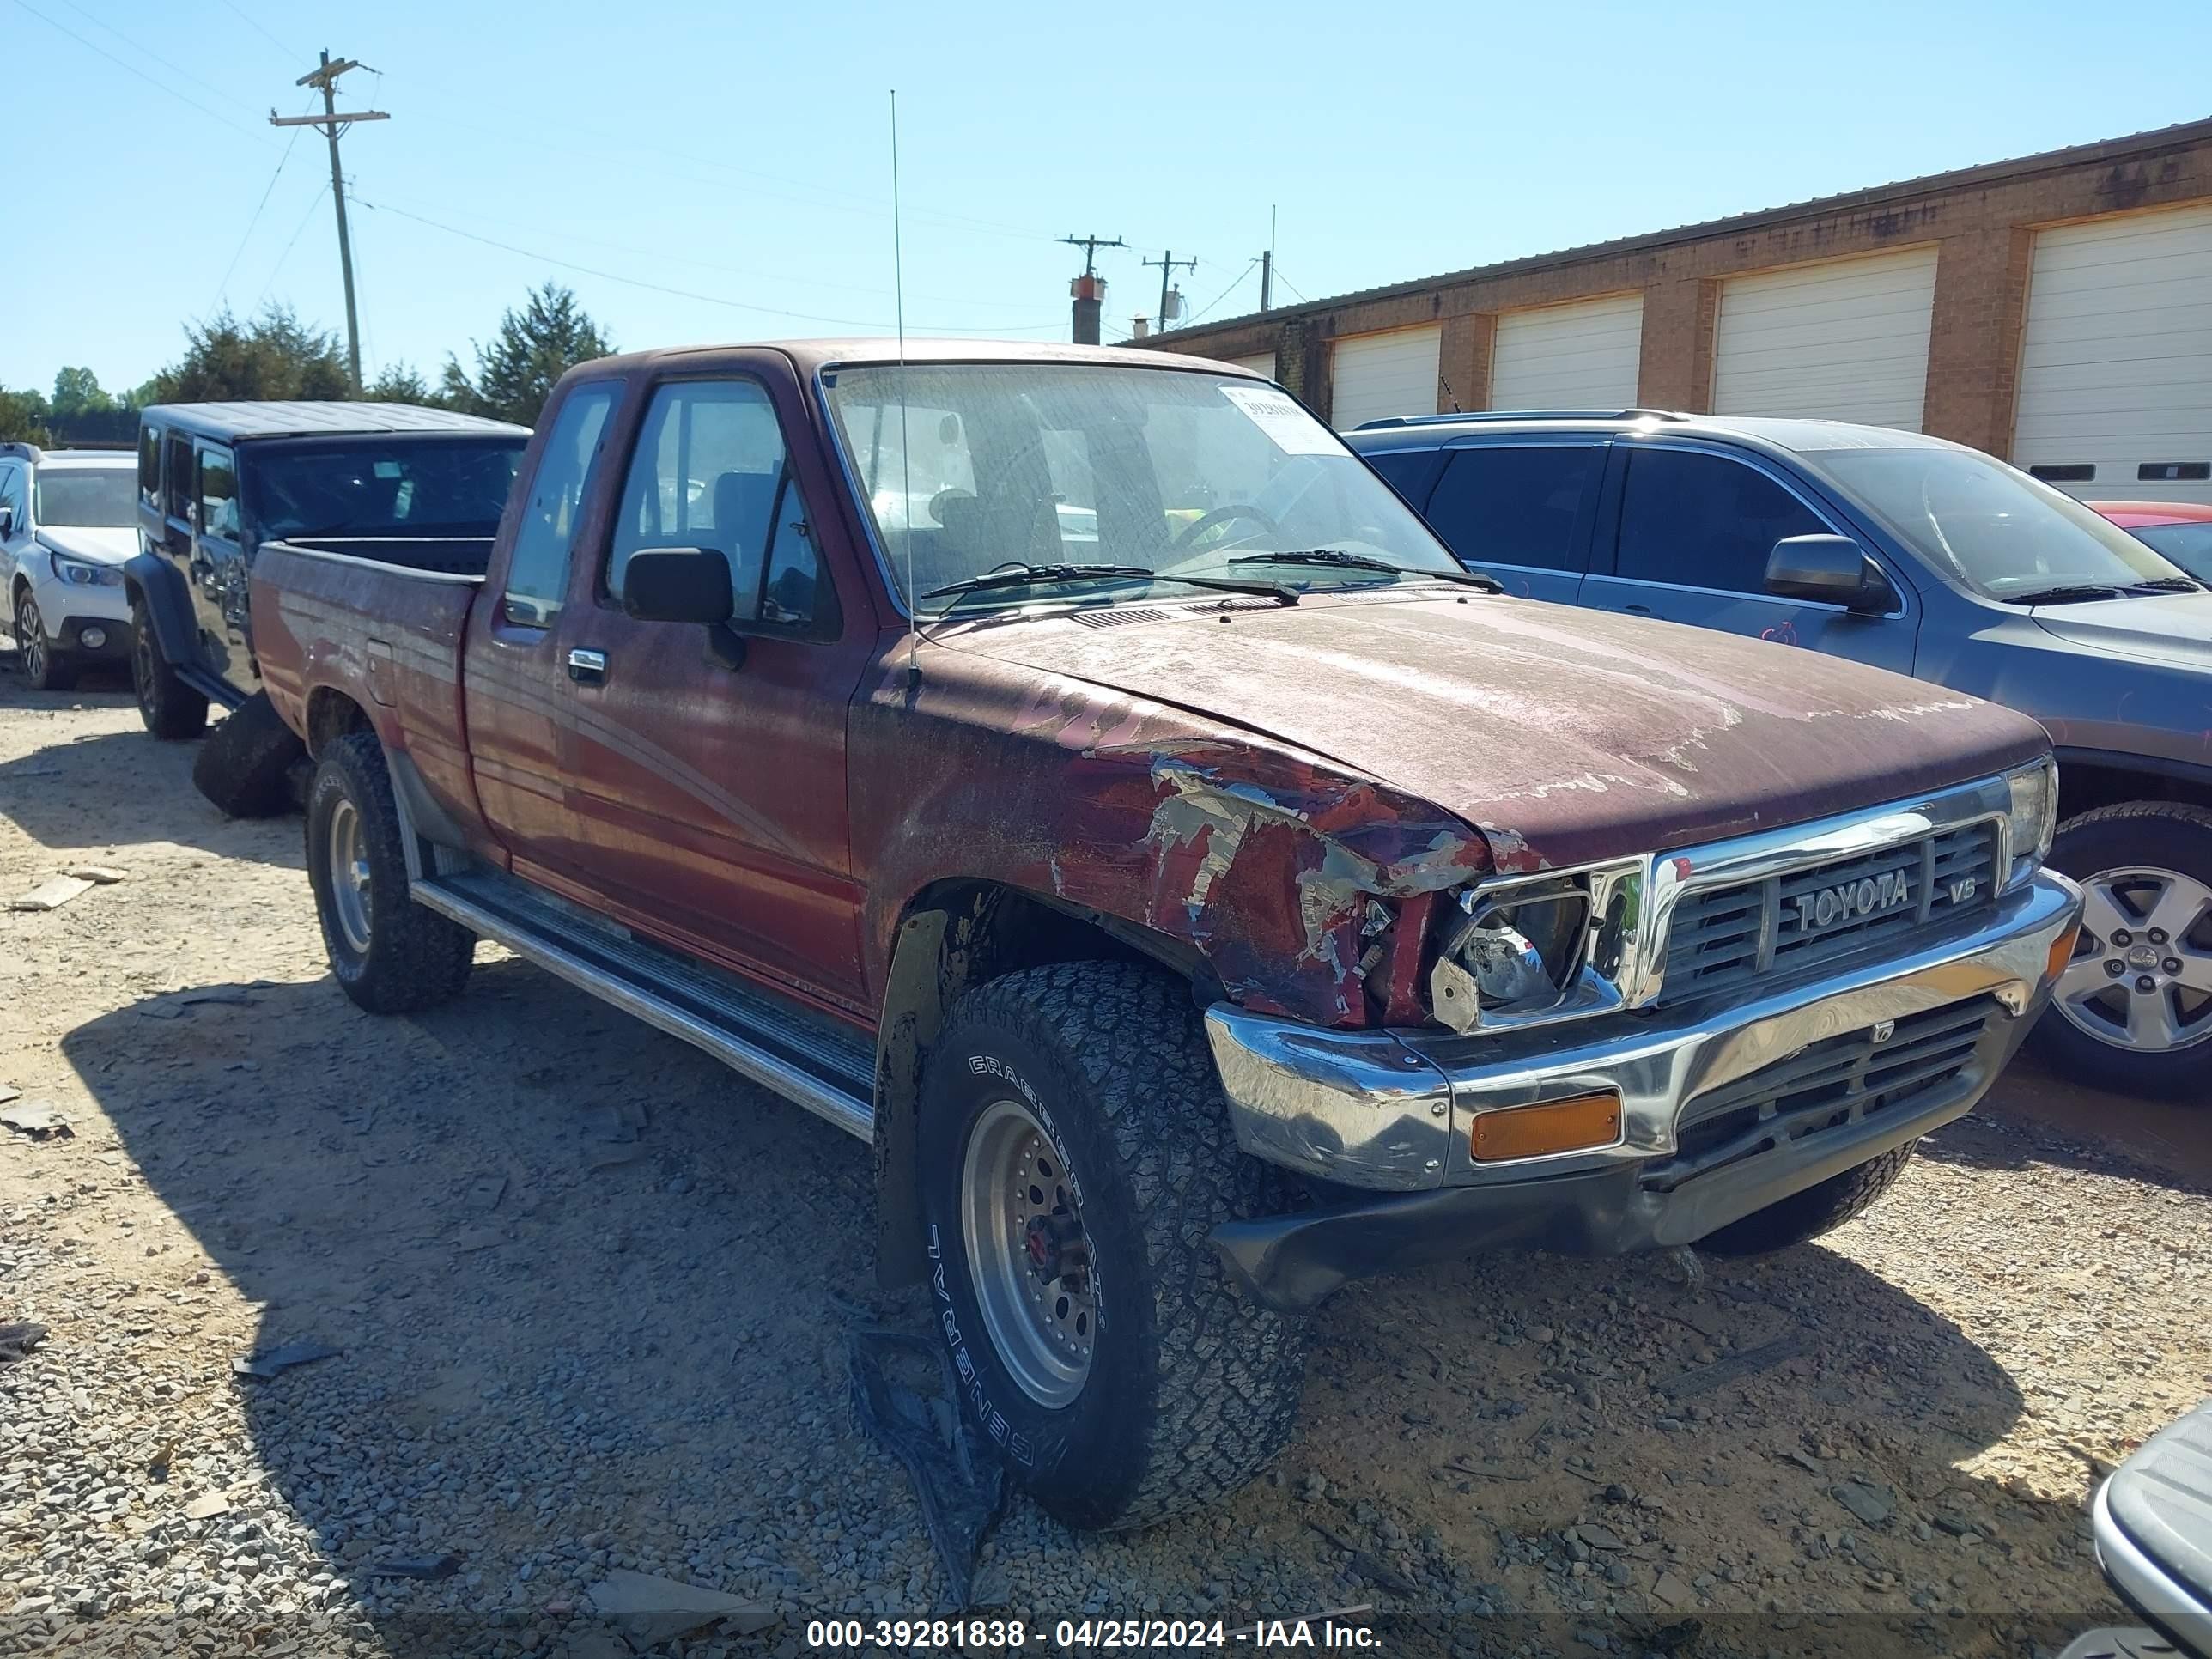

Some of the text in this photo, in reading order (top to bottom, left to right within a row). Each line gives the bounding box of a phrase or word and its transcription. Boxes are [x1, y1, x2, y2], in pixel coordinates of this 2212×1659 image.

[1796, 868, 1909, 932] TOYOTA
[1950, 876, 1977, 905] V6
[968, 1054, 1085, 1207] GRABBER
[927, 1224, 1036, 1467] GENERAL
